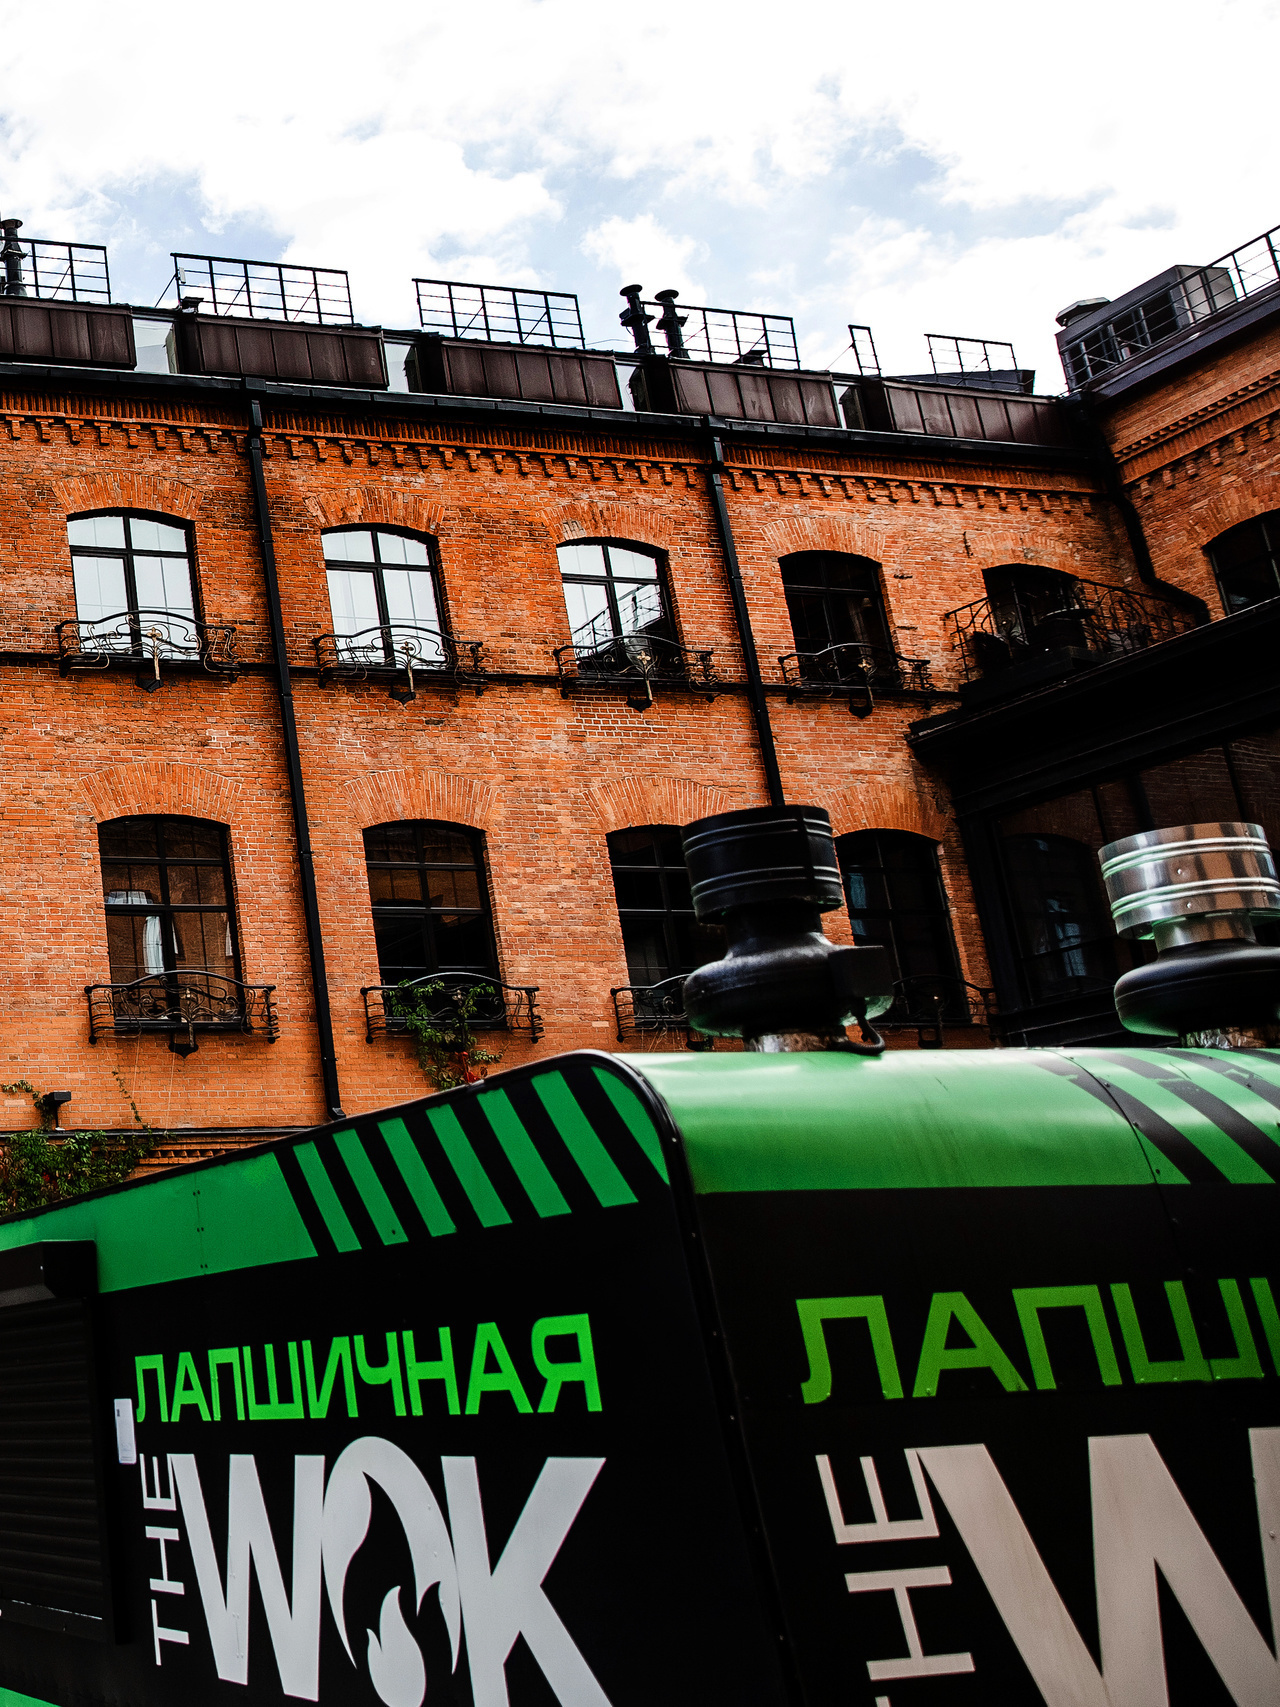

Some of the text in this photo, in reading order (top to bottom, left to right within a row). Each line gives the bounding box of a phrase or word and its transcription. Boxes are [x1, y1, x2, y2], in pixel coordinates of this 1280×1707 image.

[135, 1313, 602, 1422] ЛАПШИЧНАЯ
[140, 1453, 190, 1666] THE
[167, 1436, 613, 1707] WOK
[815, 1448, 975, 1707] HE
